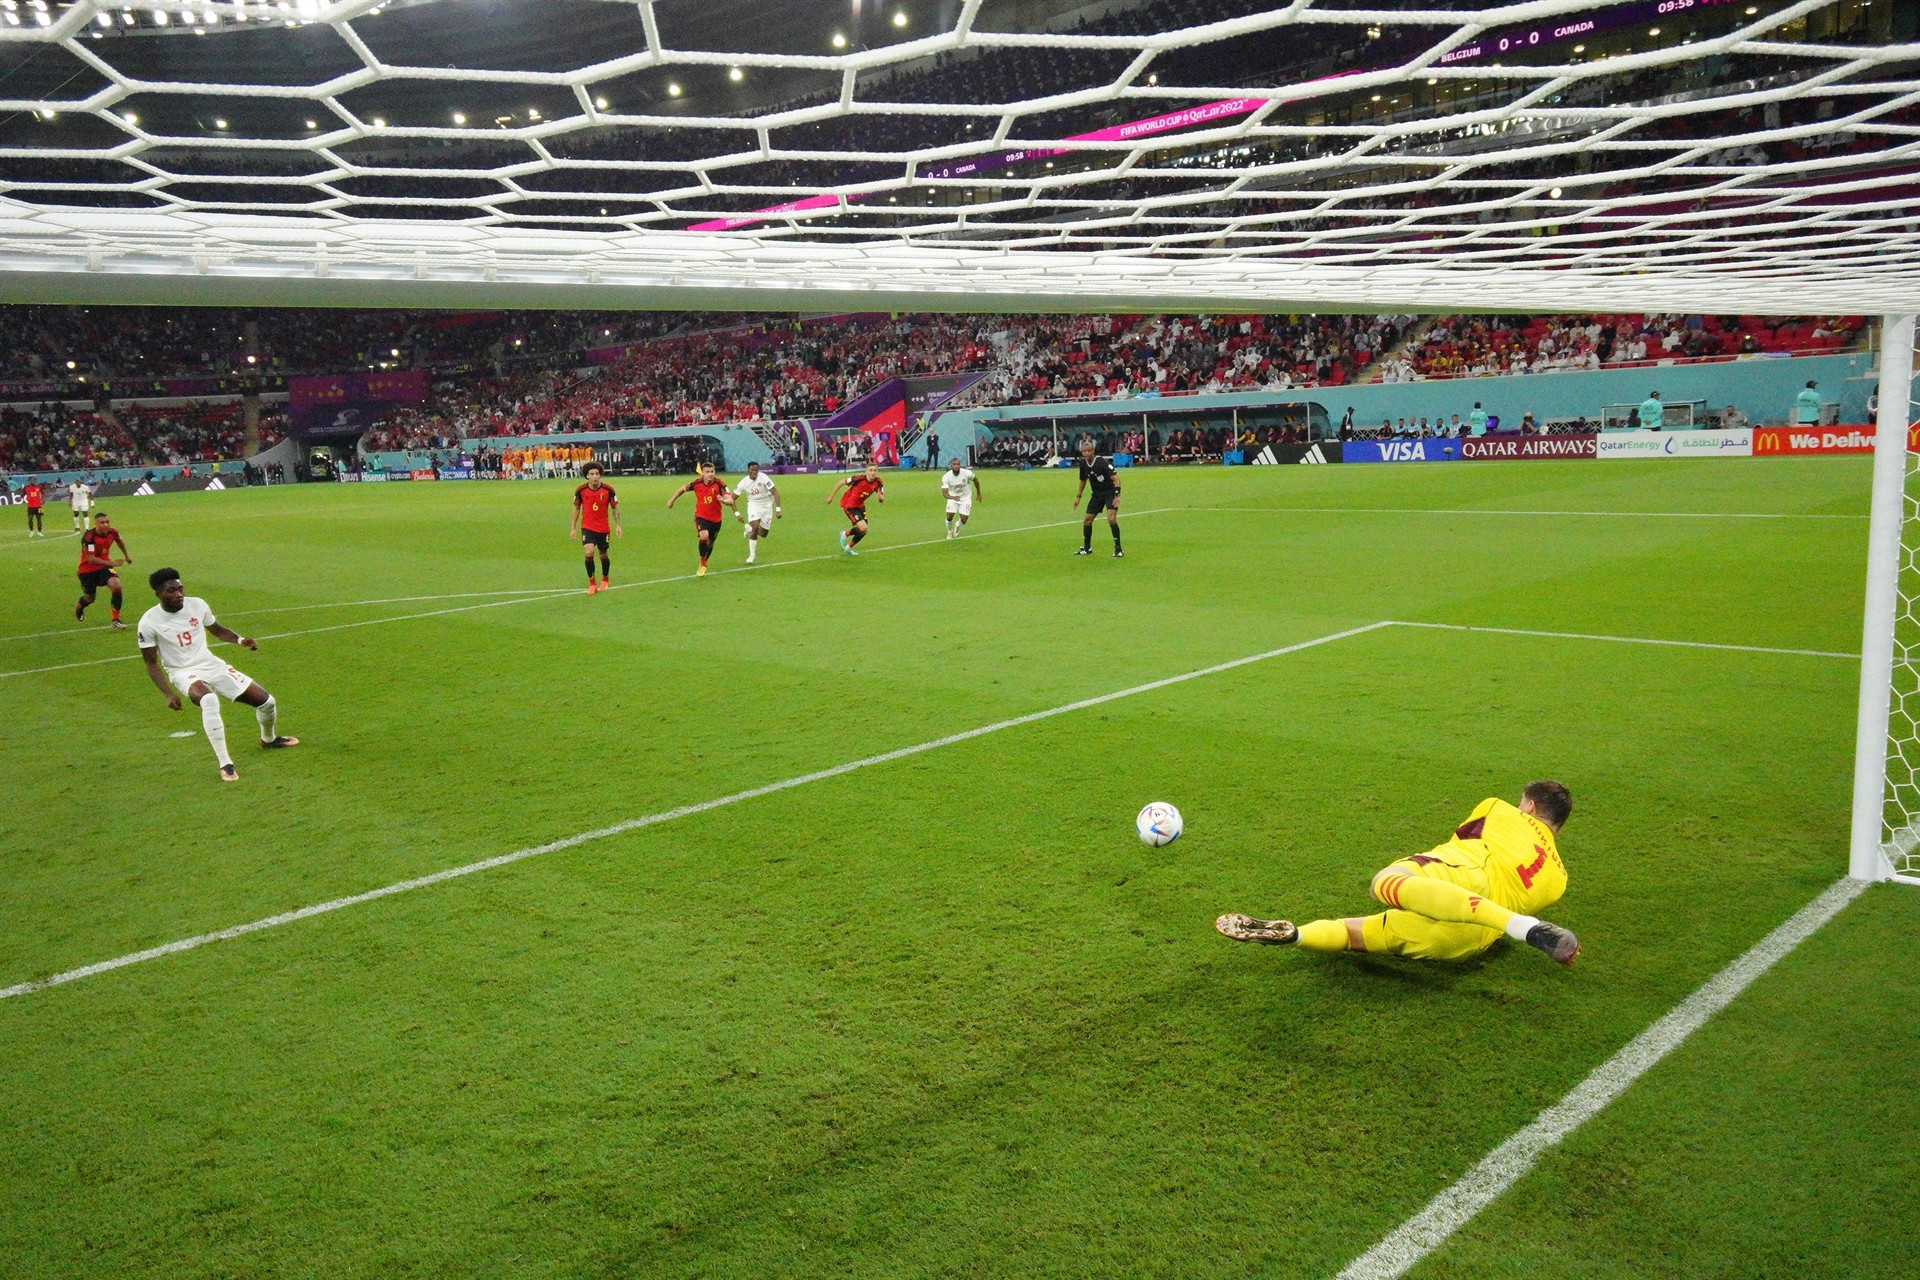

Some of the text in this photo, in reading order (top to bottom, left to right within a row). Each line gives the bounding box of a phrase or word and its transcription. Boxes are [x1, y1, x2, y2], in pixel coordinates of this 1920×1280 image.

[1441, 46, 1481, 63] BELGIUM
[1499, 38, 1509, 51] 0
[1529, 31, 1540, 44] 0
[1554, 20, 1594, 38] CANADA
[1657, 0, 1695, 14] 09:58
[1120, 126, 1138, 137] FIFA
[1137, 119, 1166, 134] WORLD
[1166, 115, 1182, 126] CUP
[955, 164, 976, 174] CANADA
[1006, 152, 1024, 162] 09:58
[1462, 439, 1596, 457] QATAR AIRWAYS
[1600, 440, 1660, 450] QatarEnergy
[1789, 434, 1819, 449] We
[1376, 442, 1426, 461] VISA
[361, 471, 387, 482] Hisense
[592, 502, 599, 511] 6
[703, 496, 713, 504] 19
[177, 631, 193, 648] 19
[1516, 843, 1548, 890] 1
